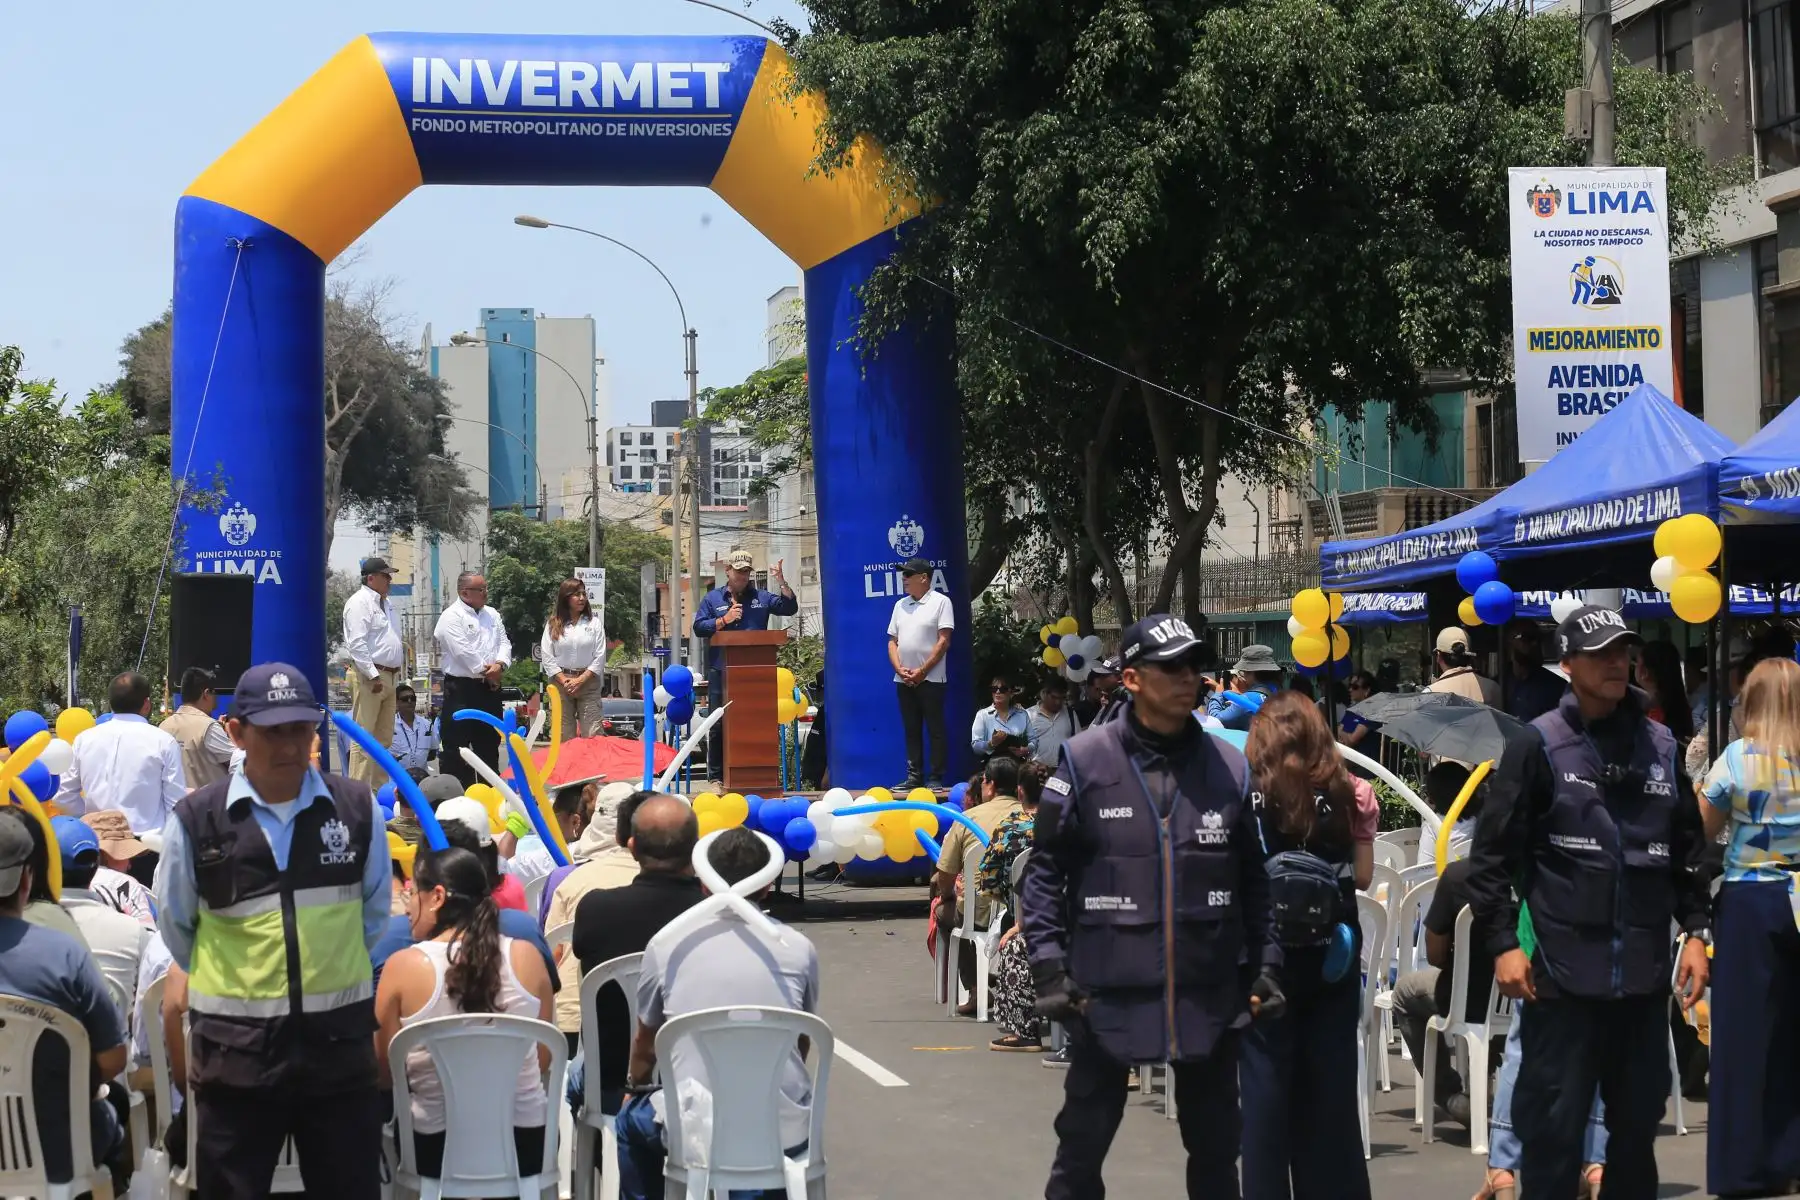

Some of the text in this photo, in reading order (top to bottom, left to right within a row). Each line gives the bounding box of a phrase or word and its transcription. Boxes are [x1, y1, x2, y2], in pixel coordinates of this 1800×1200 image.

[412, 57, 731, 109] INVERMET
[412, 118, 732, 136] FONDO METROPOLITANO DE INVERSIONES
[1567, 182, 1640, 190] MUNICIPALIDAD
[1568, 190, 1655, 214] LIMA
[1534, 230, 1545, 238] LA
[1548, 229, 1583, 238] CIUDAD
[1585, 229, 1599, 237] NO
[1544, 238, 1644, 248] NOSOTROS TAMPOCO
[1530, 329, 1660, 350] MEJORAMIENTO
[1548, 364, 1645, 388] AVENIDA
[1528, 487, 1681, 541] MUNICIPALIDAD DE LIMA
[196, 550, 282, 559] MUNICIPALIDAD DE
[1348, 526, 1480, 574] MUNICIPALIDAD DE LIMA
[1099, 807, 1133, 818] UNOES
[1199, 834, 1228, 844] LIMA
